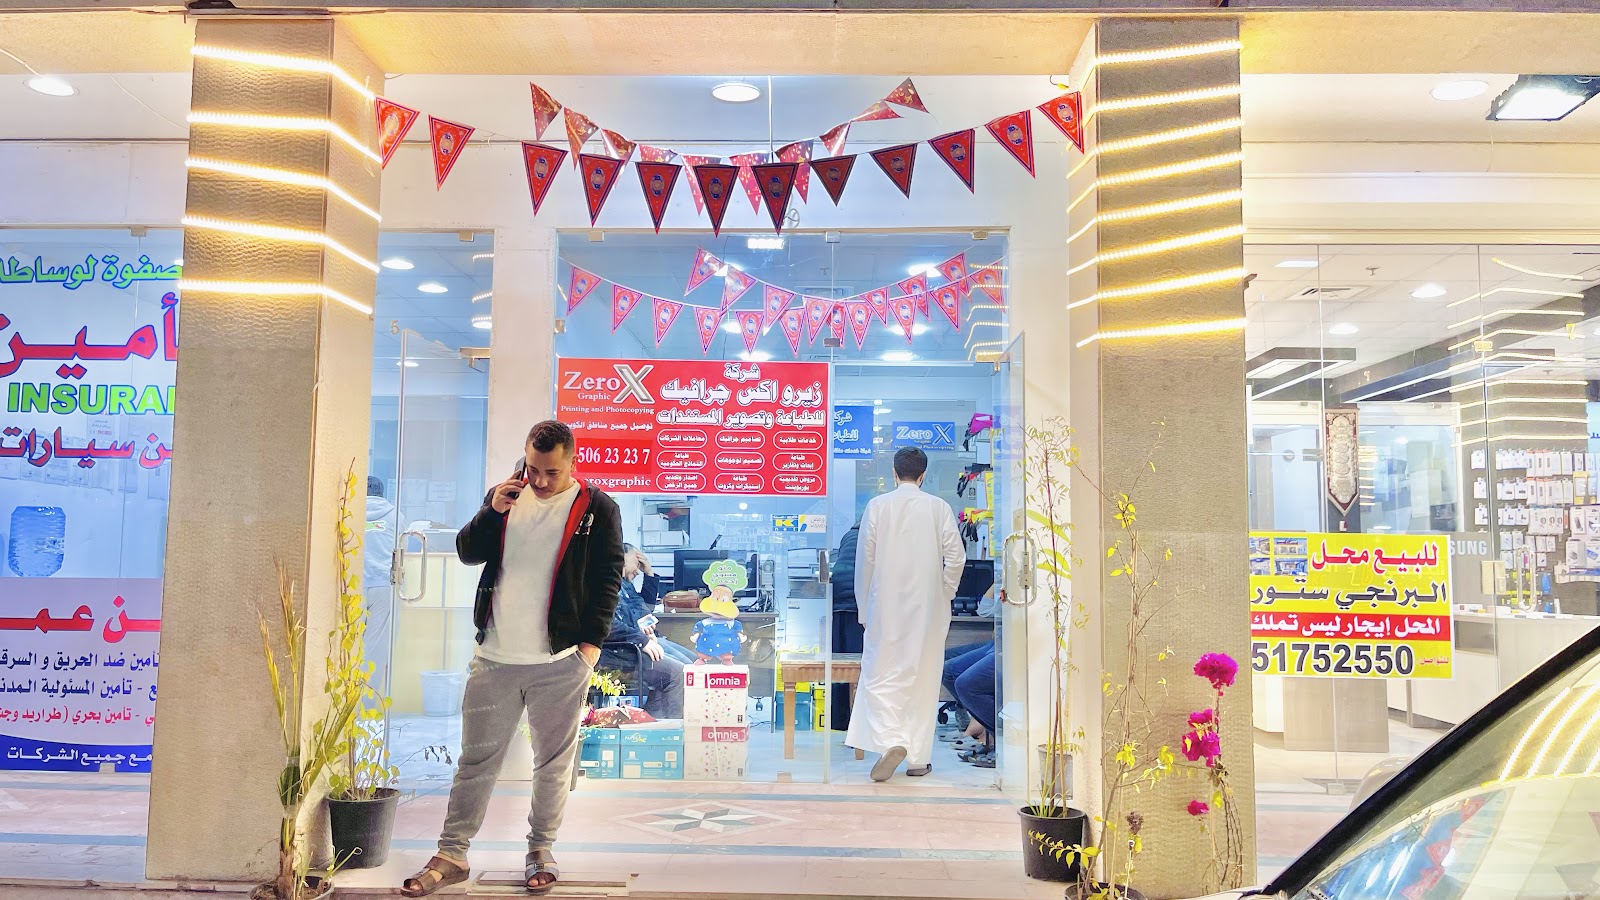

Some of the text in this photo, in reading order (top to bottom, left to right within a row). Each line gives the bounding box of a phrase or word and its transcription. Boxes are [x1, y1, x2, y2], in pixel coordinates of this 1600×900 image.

[0, 254, 182, 290] صفوة لوساط
[0, 292, 178, 379] أمين
[723, 362, 761, 382] شركة
[7, 382, 176, 415] INSURA
[577, 392, 612, 401] Graphic
[660, 378, 823, 407] زيرو اكس جرافيك
[561, 405, 589, 414] Printing
[605, 406, 654, 415] Photocopying
[656, 407, 826, 430] للطباعة وتصوير المستندات
[834, 410, 853, 426] شرك
[630, 422, 653, 431] توصيل
[0, 426, 135, 468] سيارات
[578, 447, 650, 464] 506 23 23 7
[585, 476, 652, 489] roxgraphic
[1312, 539, 1438, 574] للبيع محل
[1450, 540, 1487, 556] SUNG
[1251, 578, 1447, 610] البرنجي ستور
[1251, 613, 1440, 638] المحل إيجار ليس تملك
[0, 648, 37, 670] السرق
[54, 652, 98, 671] الحريق
[103, 651, 126, 667] ضد
[1252, 641, 1414, 675] 51752550
[0, 677, 37, 694] المدن
[100, 677, 132, 699] تأمين
[709, 676, 740, 686] omnia
[72, 709, 101, 725] بحري
[105, 705, 131, 725] تأمين
[707, 730, 739, 739] omnia
[7, 747, 79, 763] الشركات
[80, 748, 126, 766] جميع
